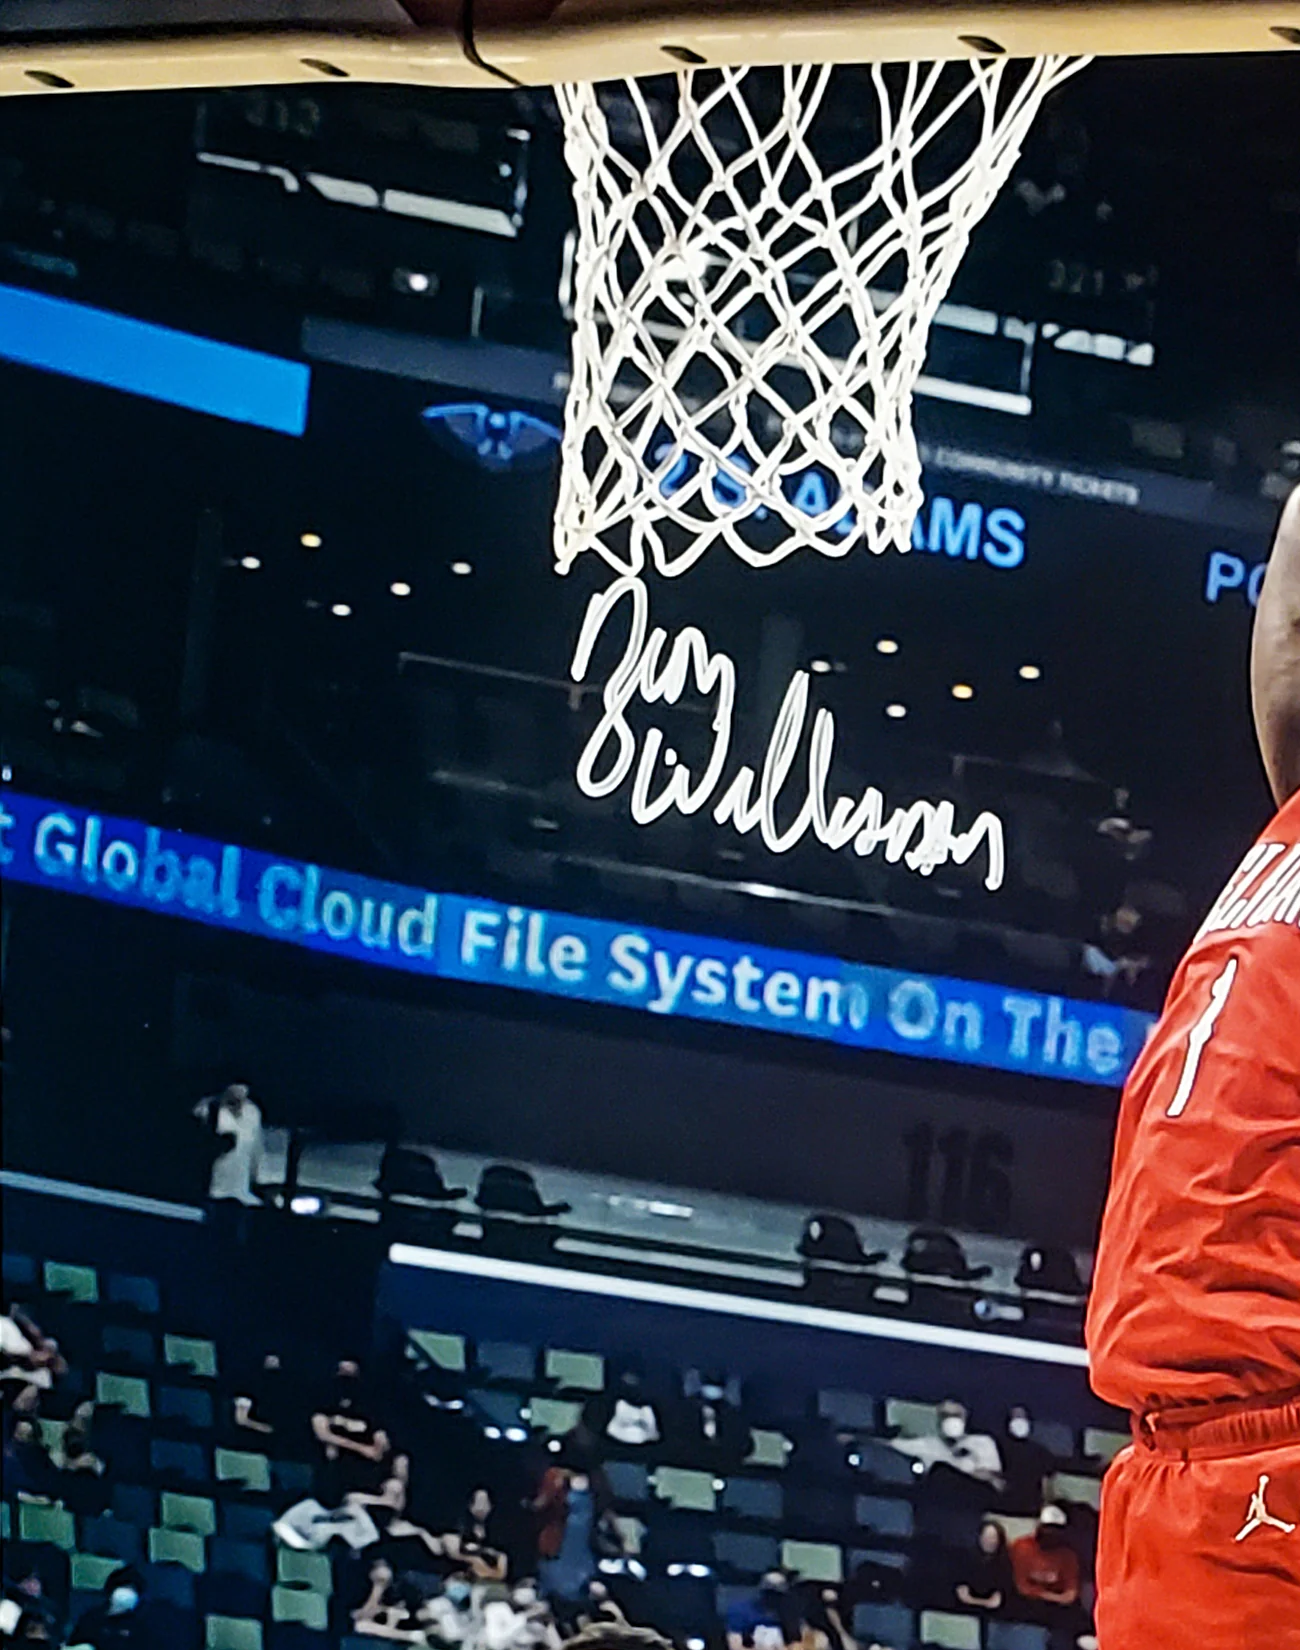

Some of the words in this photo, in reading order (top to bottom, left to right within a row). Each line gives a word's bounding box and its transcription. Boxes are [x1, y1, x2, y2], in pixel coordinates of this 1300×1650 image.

[35, 812, 242, 918] Global
[257, 864, 440, 957] Cloud
[460, 906, 590, 983] File
[605, 932, 869, 1034] System
[888, 979, 984, 1052] On
[1003, 996, 1124, 1075] The
[1165, 956, 1239, 1118] 1
